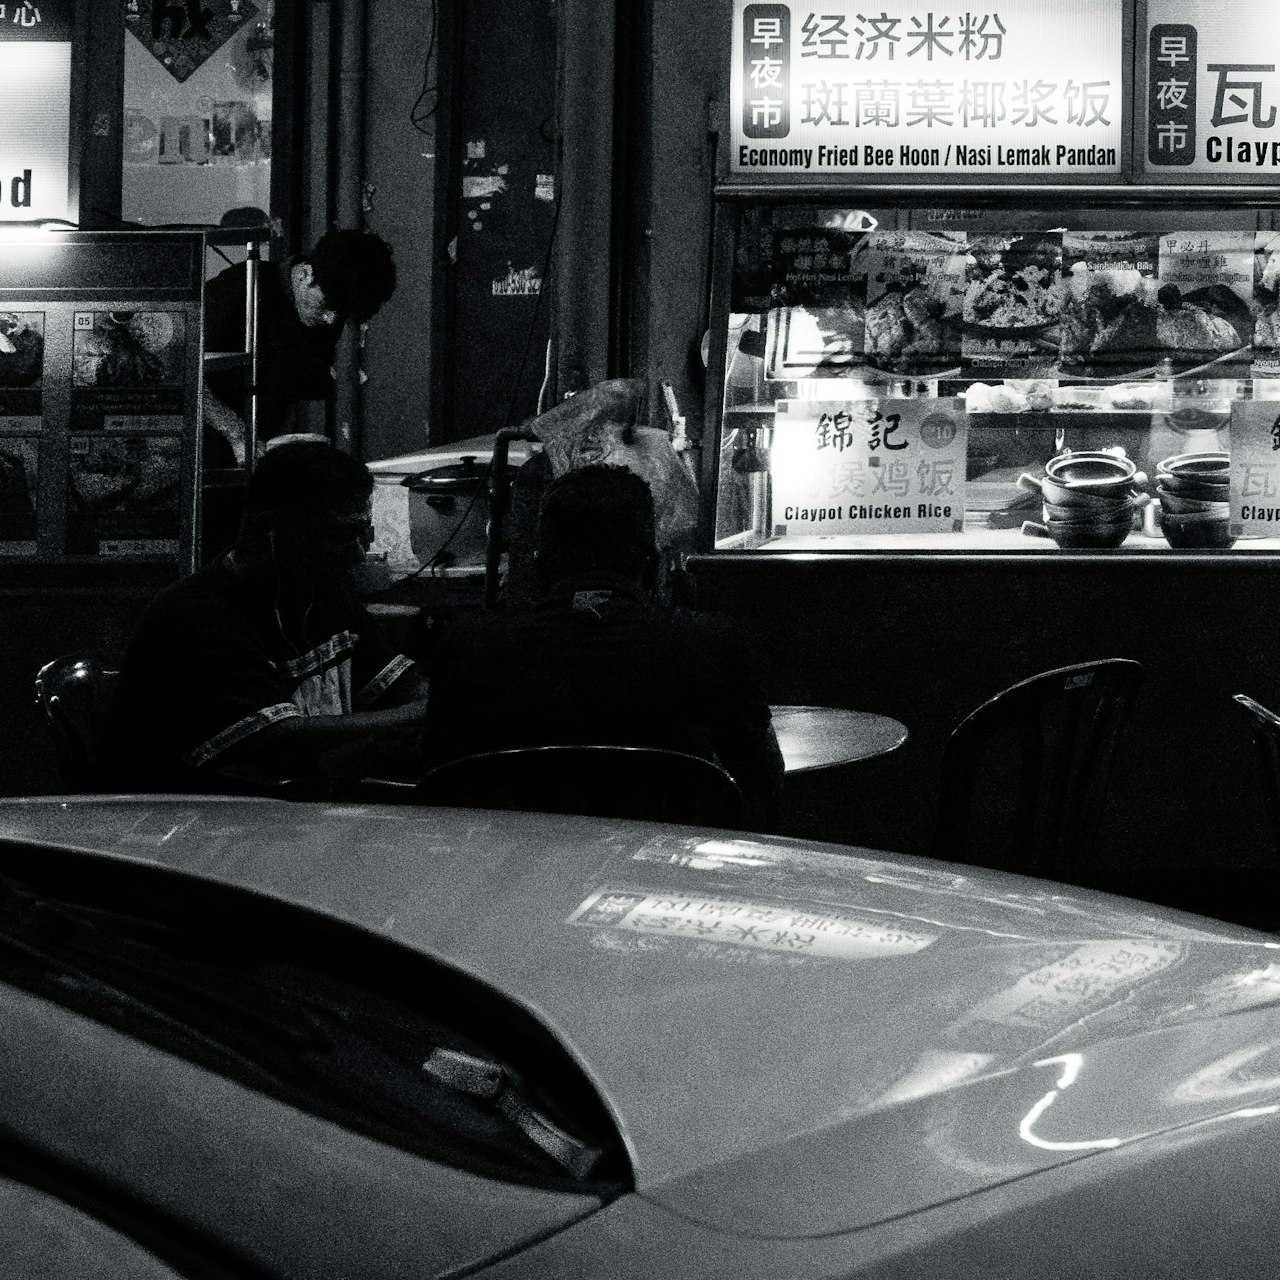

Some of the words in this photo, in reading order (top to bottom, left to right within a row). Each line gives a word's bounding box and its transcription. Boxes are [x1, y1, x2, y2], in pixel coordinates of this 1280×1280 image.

[800, 12, 1007, 61] 经济米粉
[750, 18, 783, 129] 早夜市
[1157, 36, 1189, 154] 早夜市
[739, 145, 812, 168] Economy
[818, 145, 858, 166] Fried
[864, 146, 894, 166] Bee
[899, 146, 939, 166] Hoon
[956, 146, 991, 166] Nasi
[997, 146, 1050, 166] Lemak
[1056, 146, 1116, 166] Pandan
[816, 411, 909, 452] 錦記
[785, 506, 842, 522] Claypot
[850, 505, 911, 519] Chicken
[918, 503, 951, 518] Rice
